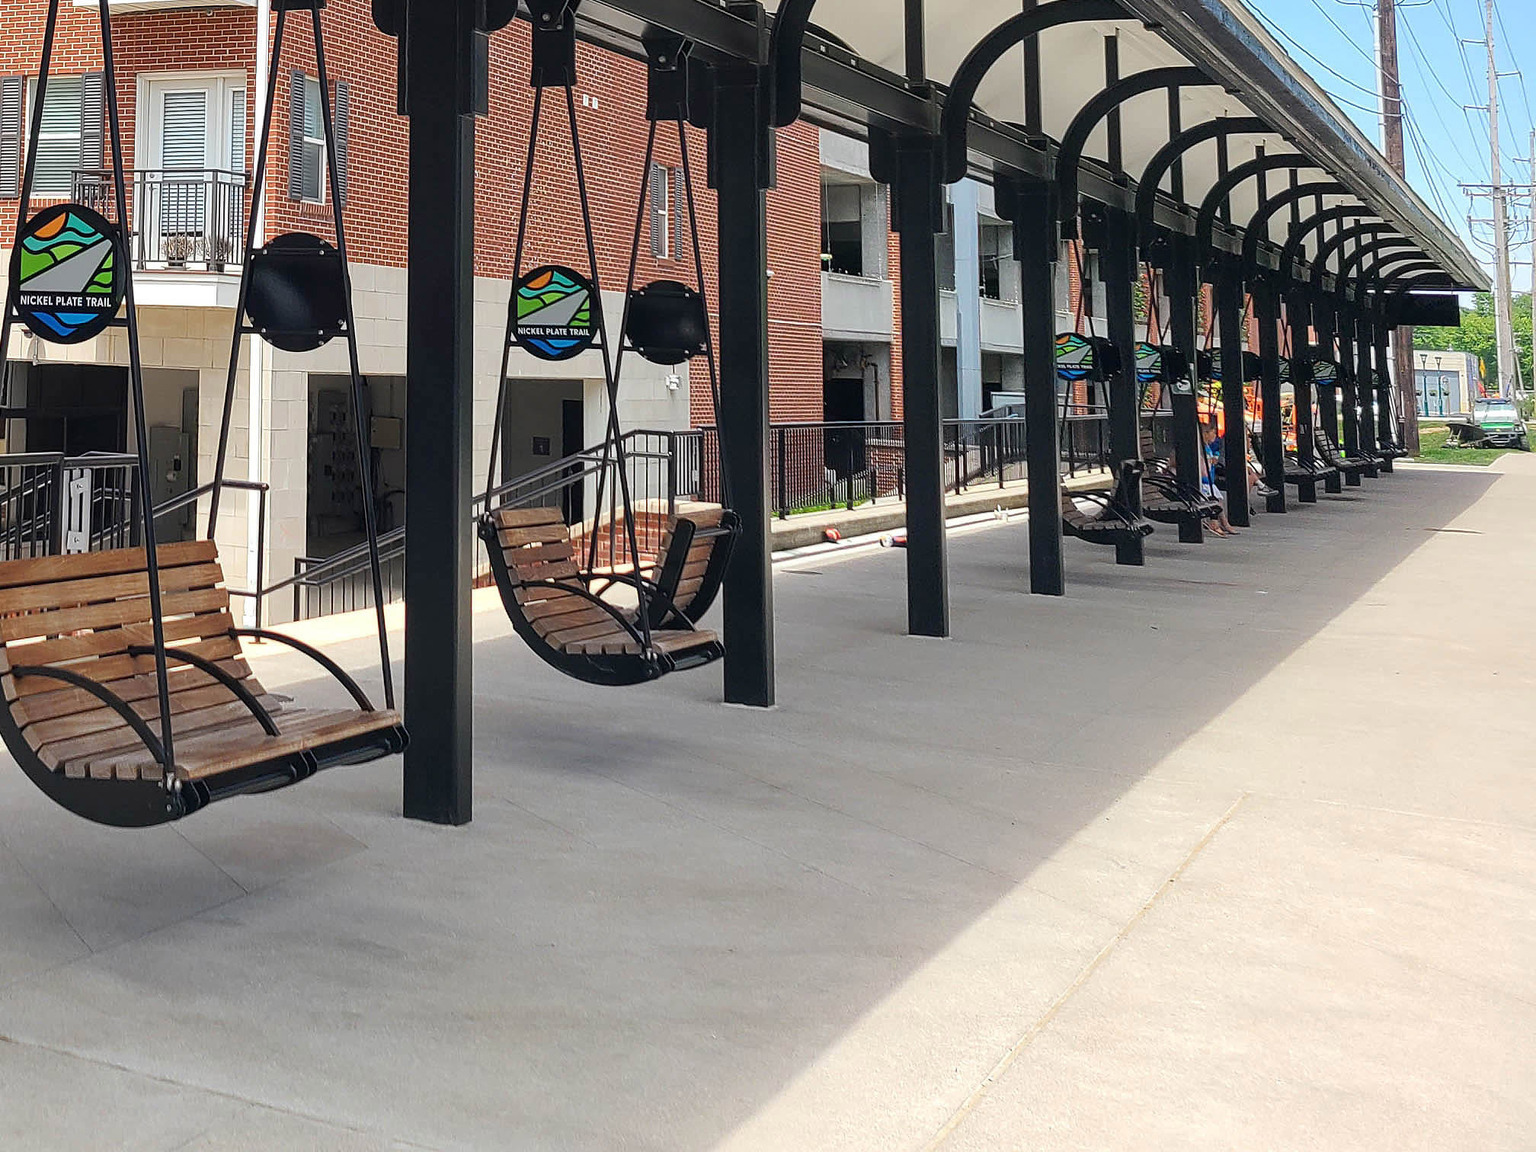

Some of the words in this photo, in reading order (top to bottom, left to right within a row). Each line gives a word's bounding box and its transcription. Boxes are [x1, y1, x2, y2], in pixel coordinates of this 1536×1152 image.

[20, 295, 53, 306] NICKEL
[56, 296, 83, 307] PLATE
[86, 297, 112, 308] TRAIL
[517, 327, 544, 335] NICKEL
[546, 328, 567, 336] PLATE
[569, 328, 590, 336] TRAIL
